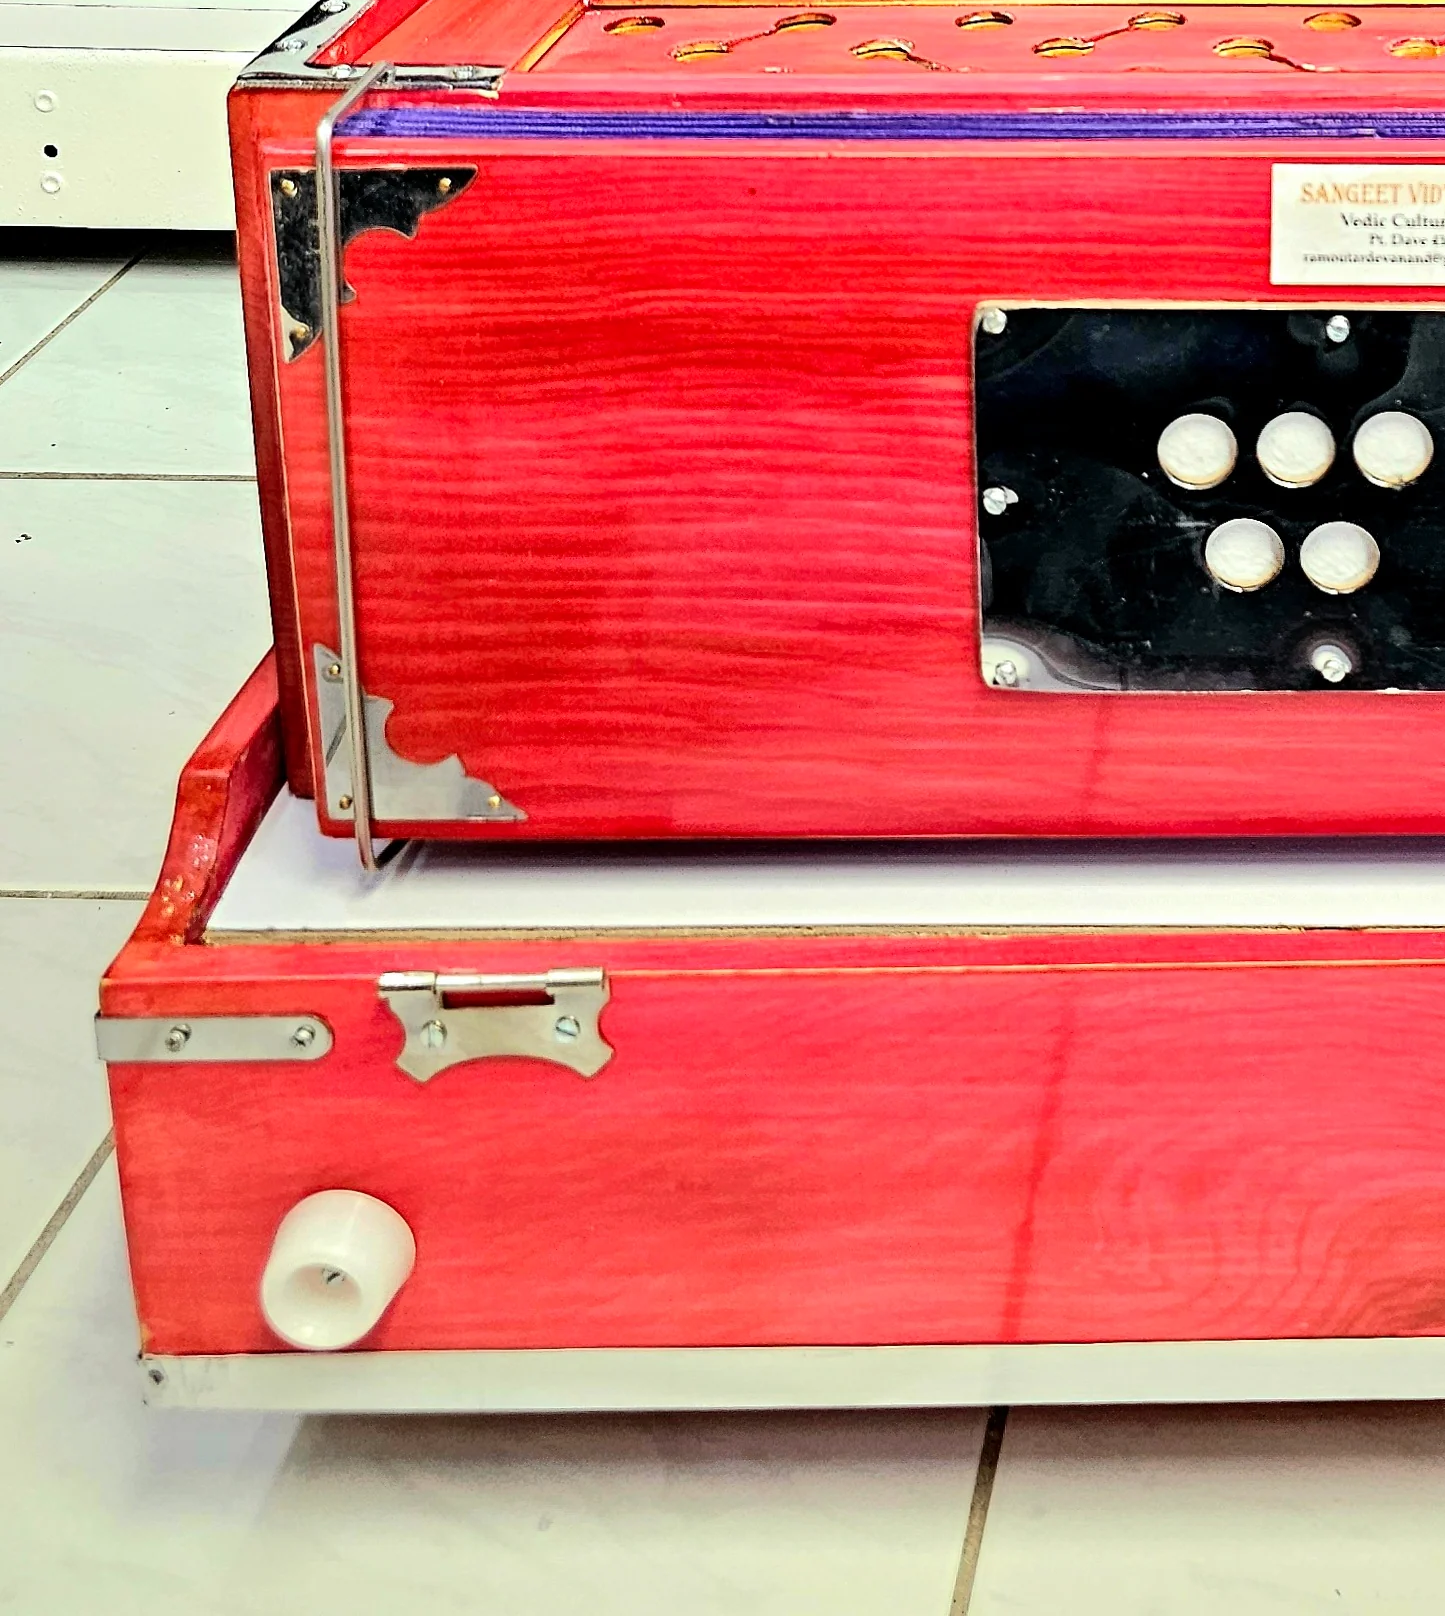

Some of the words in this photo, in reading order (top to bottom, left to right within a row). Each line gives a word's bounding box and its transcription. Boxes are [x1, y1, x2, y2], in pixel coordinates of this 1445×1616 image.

[1300, 182, 1404, 205] SANGEET
[1340, 212, 1387, 227] Vedic
[1391, 233, 1427, 245] Dave
